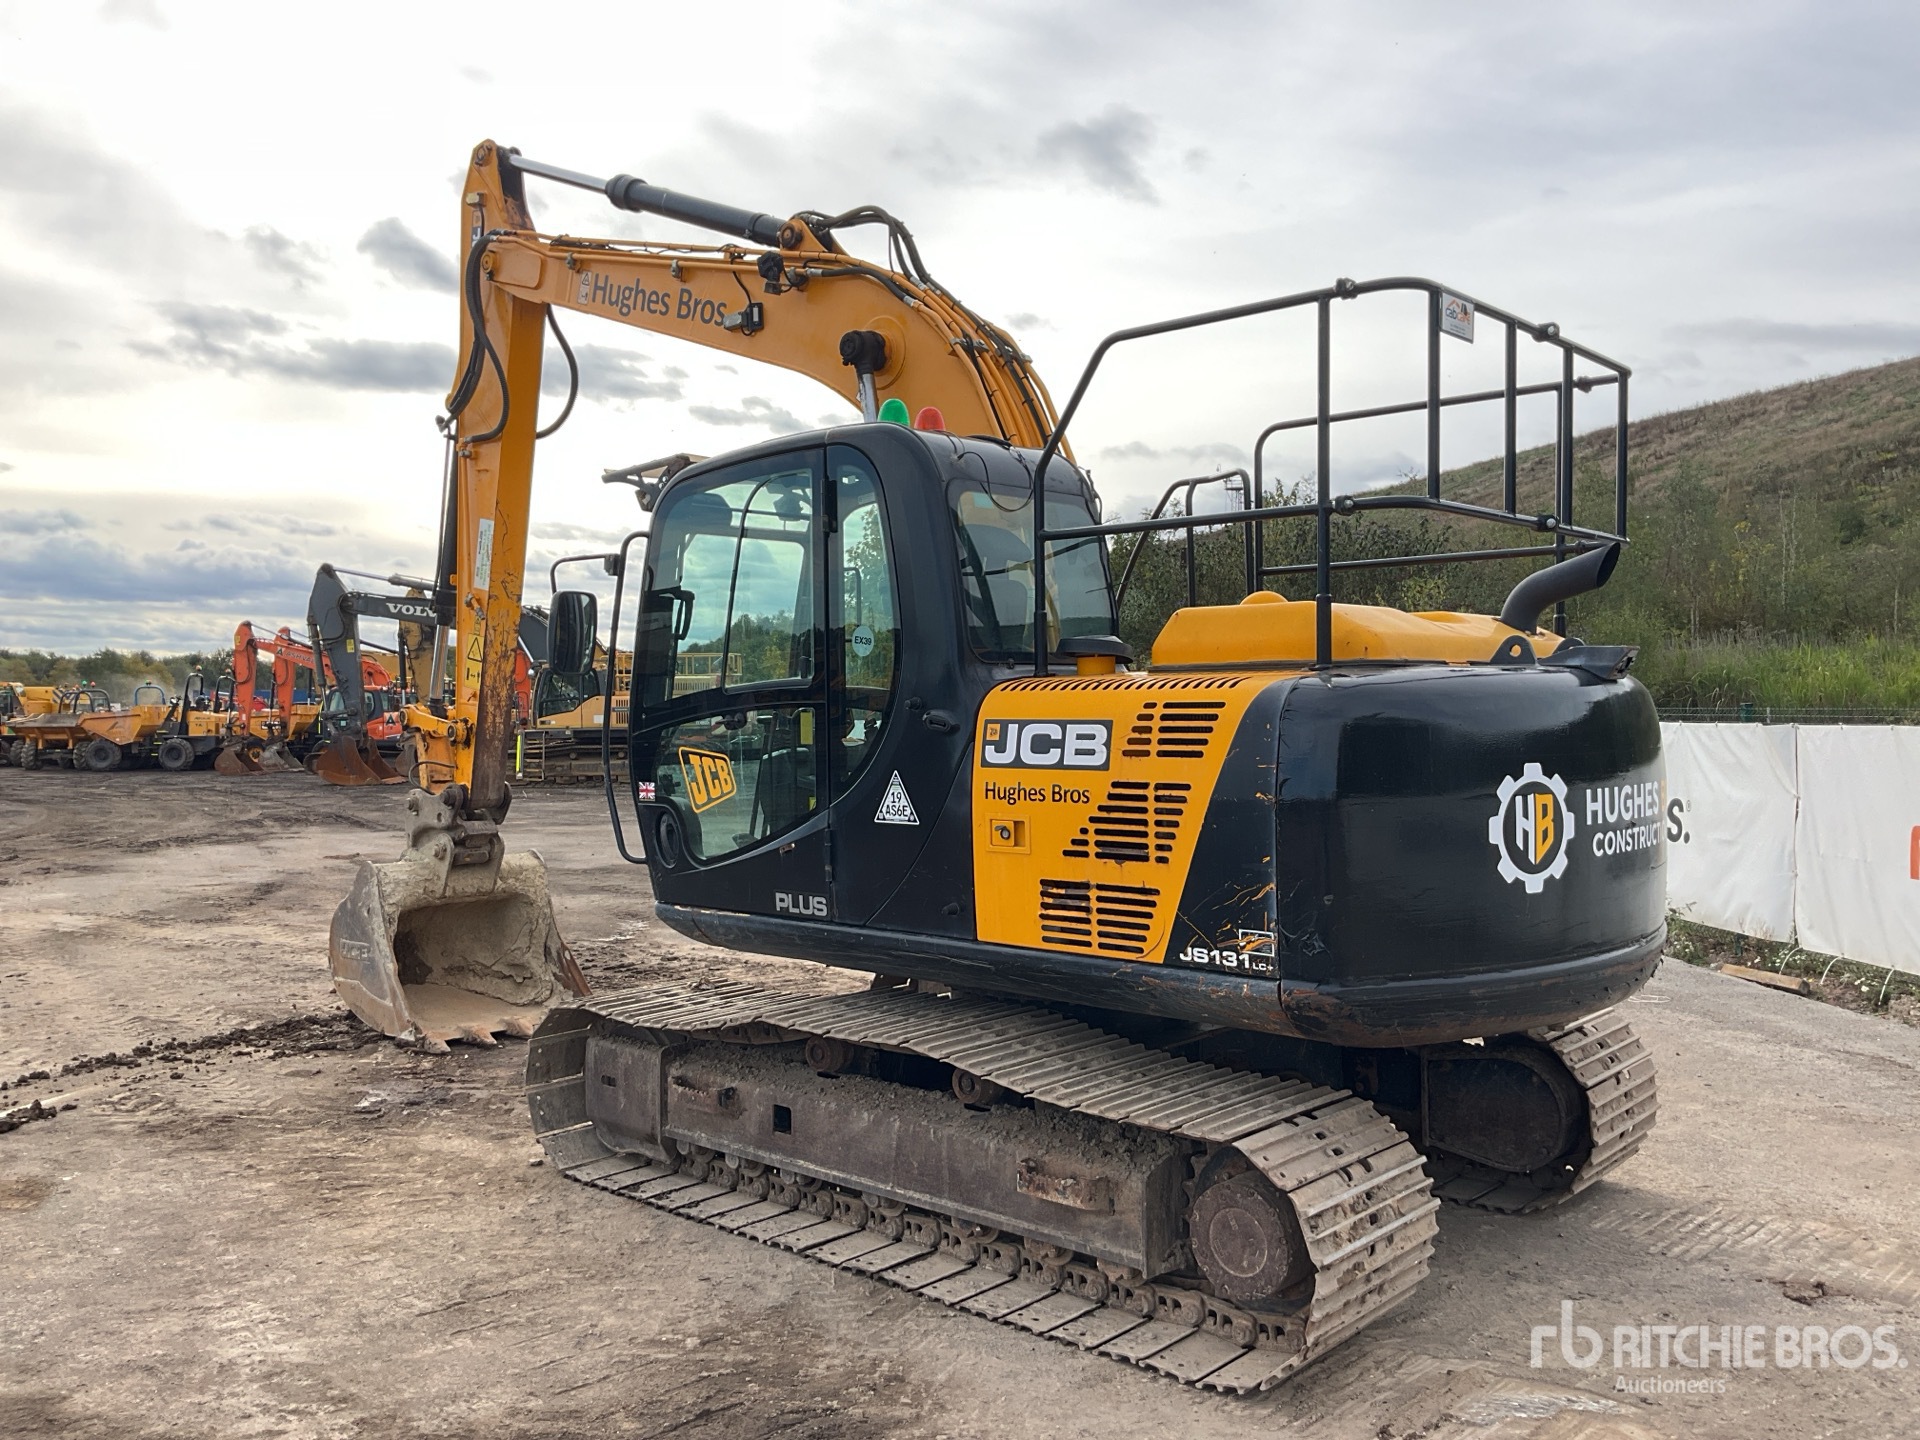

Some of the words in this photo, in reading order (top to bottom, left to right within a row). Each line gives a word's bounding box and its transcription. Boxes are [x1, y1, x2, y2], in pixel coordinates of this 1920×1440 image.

[592, 273, 671, 317] Hughes
[677, 287, 728, 327] Bros
[854, 635, 872, 646] EX39
[984, 723, 1108, 766] JCB
[688, 754, 733, 806] JCB
[890, 791, 902, 804] 19
[985, 781, 1046, 806] Hughes
[1052, 784, 1090, 804] Bros
[1585, 780, 1659, 826] HUGHES
[885, 804, 909, 817] AS6E
[1514, 792, 1555, 866] HB
[775, 891, 828, 917] PLUS
[1179, 946, 1251, 969] JS131
